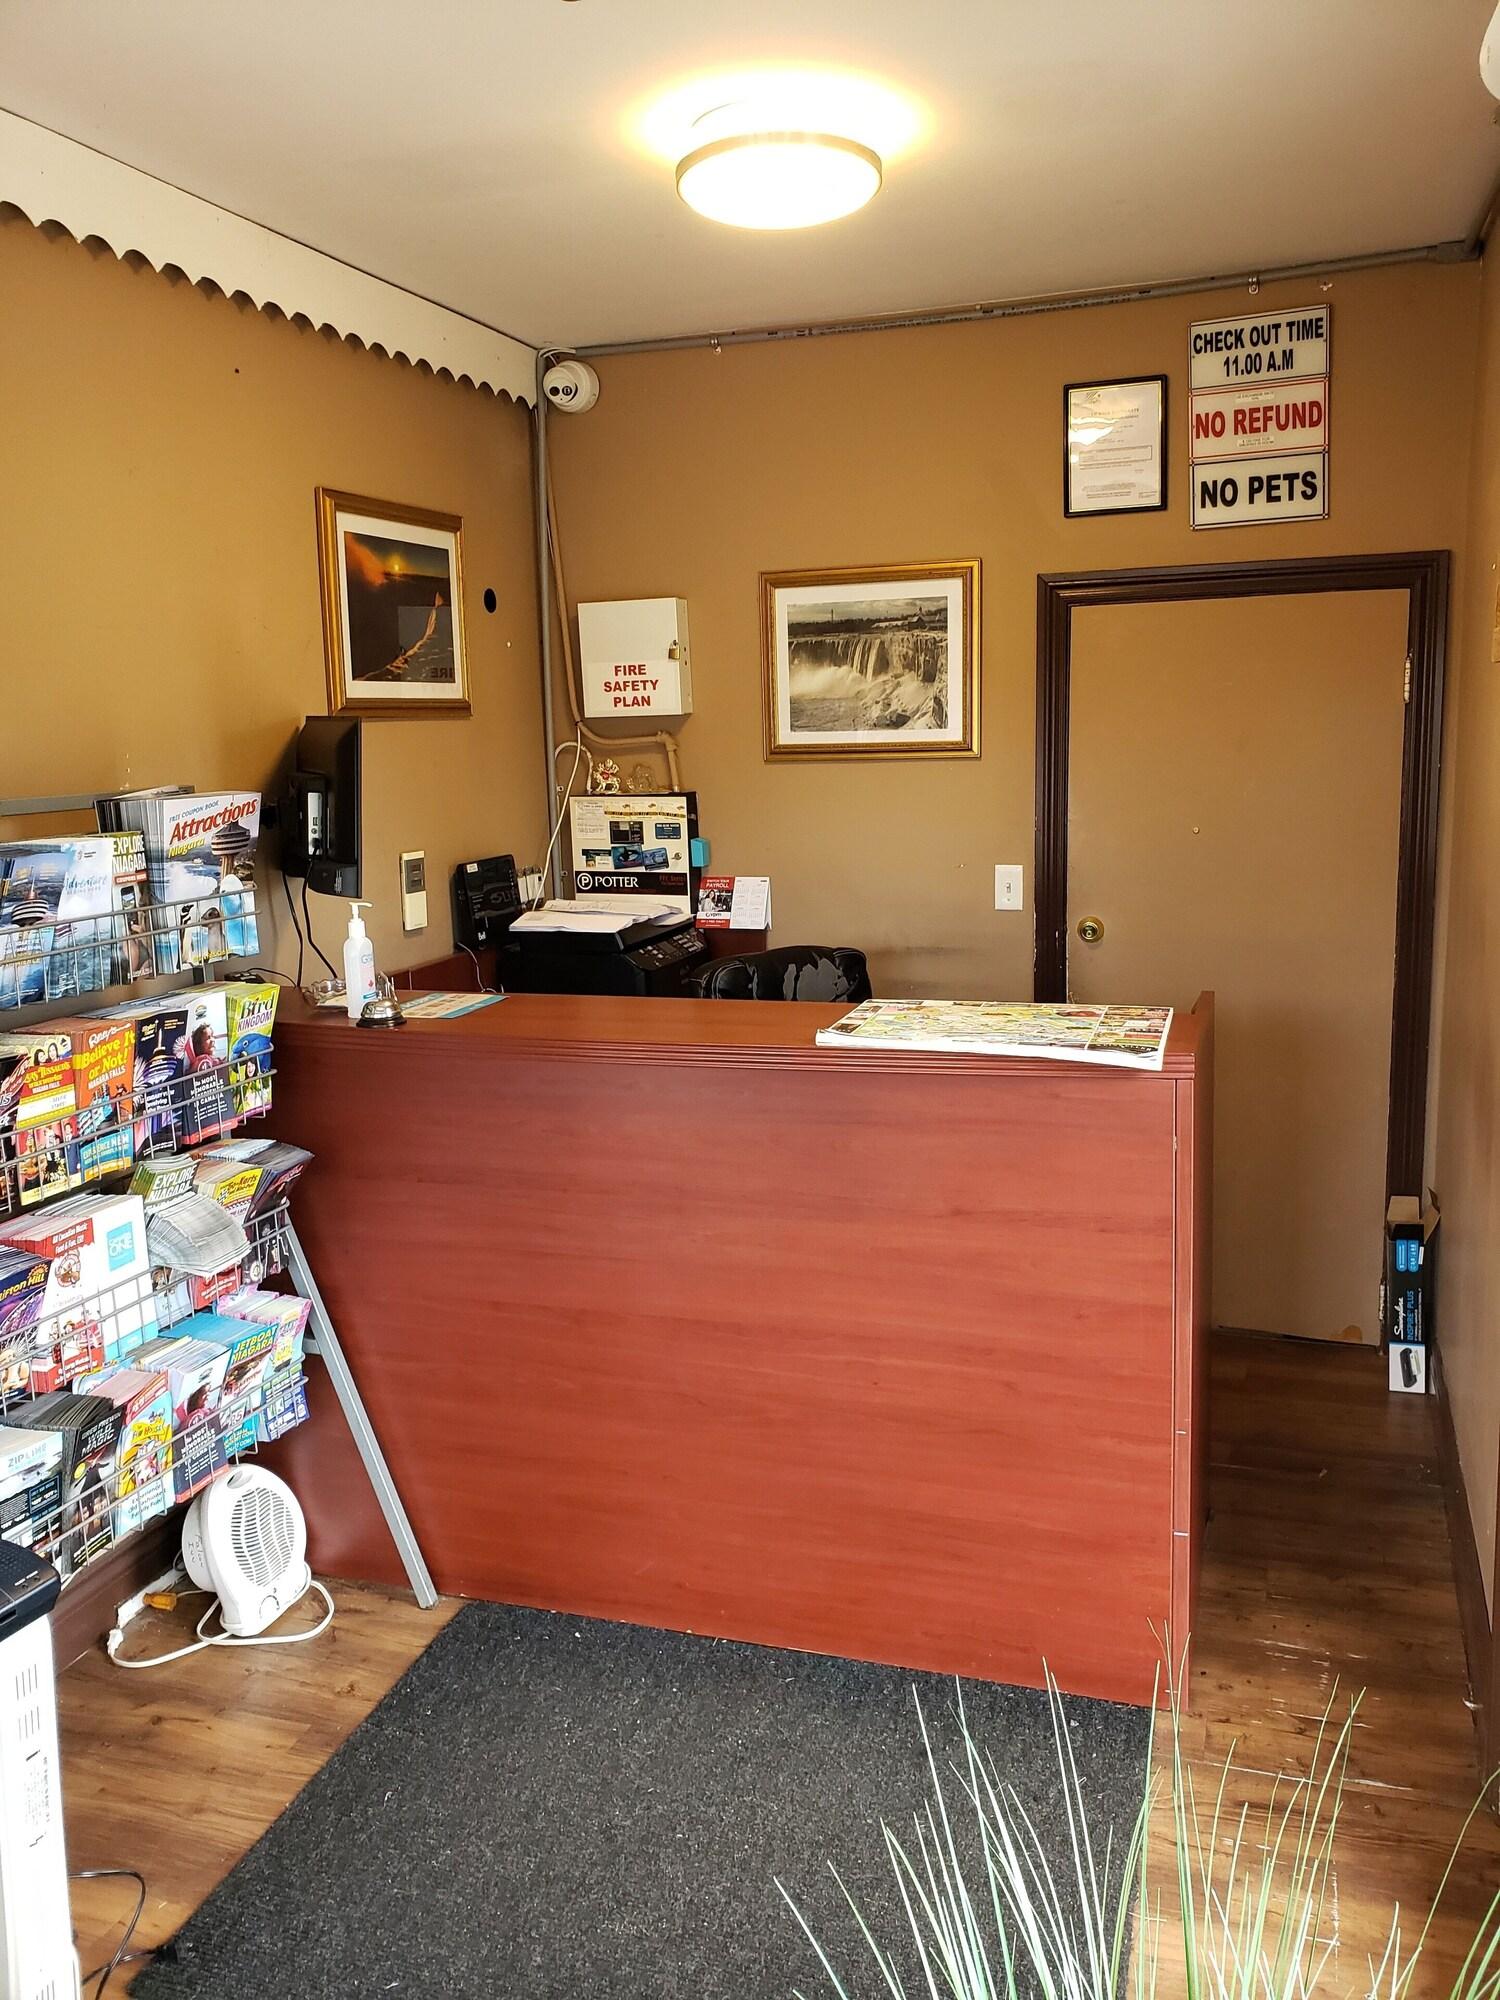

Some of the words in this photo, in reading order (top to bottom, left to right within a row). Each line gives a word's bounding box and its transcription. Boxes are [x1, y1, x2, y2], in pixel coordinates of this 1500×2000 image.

[1193, 328, 1245, 354] CHECK
[1249, 322, 1281, 347] OUT
[1286, 317, 1324, 342] TIME
[1223, 352, 1262, 377] 11.00
[1266, 348, 1294, 372] A.M
[1195, 411, 1226, 439] NO
[1233, 400, 1323, 435] REFUND
[1200, 478, 1239, 509] NO
[1248, 471, 1318, 505] PETS
[614, 664, 647, 676] FIRE
[603, 680, 659, 693] SAFETY
[613, 695, 651, 708] PLAN
[169, 799, 258, 845] Attractions
[112, 834, 145, 855] EXPLORE
[168, 838, 206, 859] Niagara
[112, 852, 147, 873] NIAGARA
[594, 876, 639, 888] POTTER
[240, 991, 275, 1020] Bird
[237, 1010, 272, 1031] KINGDOM
[82, 1039, 120, 1065] Believe
[123, 1031, 135, 1047] It
[88, 1066, 100, 1080] or
[101, 1047, 128, 1071] Not!
[152, 1163, 199, 1190] EXPLORE
[147, 1180, 193, 1203] NIAGARA
[27, 1272, 46, 1287] Hill
[232, 1337, 273, 1363] NIAGARA
[234, 1325, 278, 1352] JETBOAT
[81, 1429, 114, 1457] MAGIC
